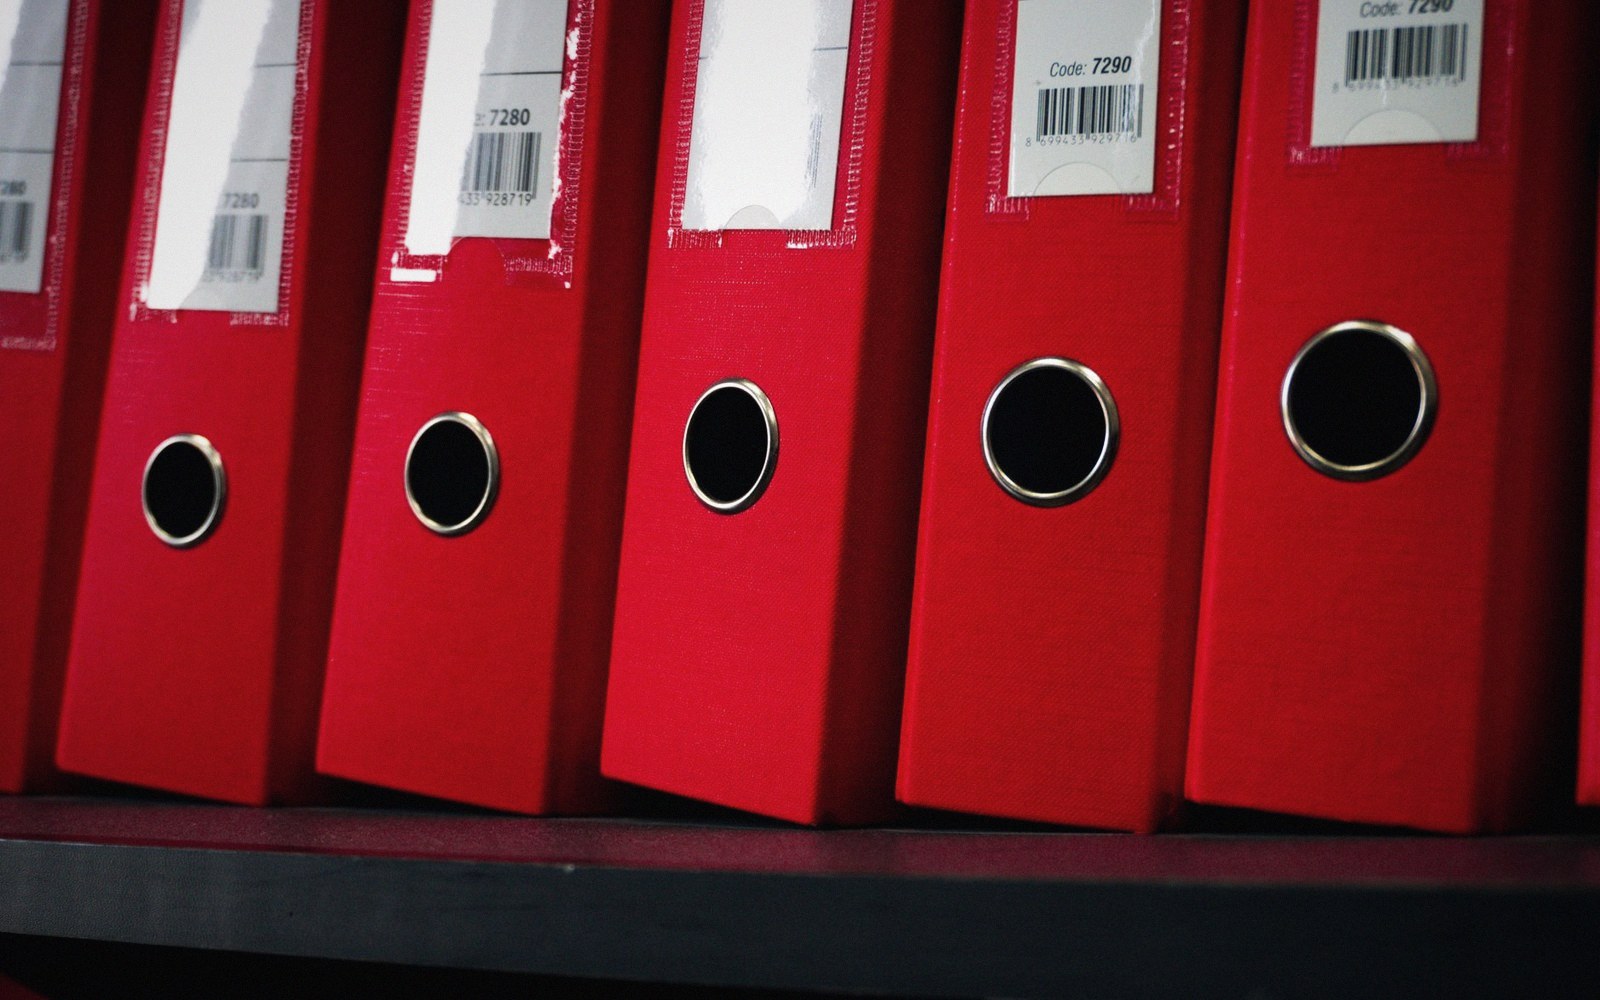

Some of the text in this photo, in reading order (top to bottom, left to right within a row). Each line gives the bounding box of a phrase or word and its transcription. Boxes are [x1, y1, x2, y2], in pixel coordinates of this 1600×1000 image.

[1360, 2, 1401, 18] Code:
[1049, 55, 1132, 77] Code: 7290
[489, 107, 531, 126] 7280
[1025, 136, 1032, 147] 8
[223, 192, 260, 209] 7280
